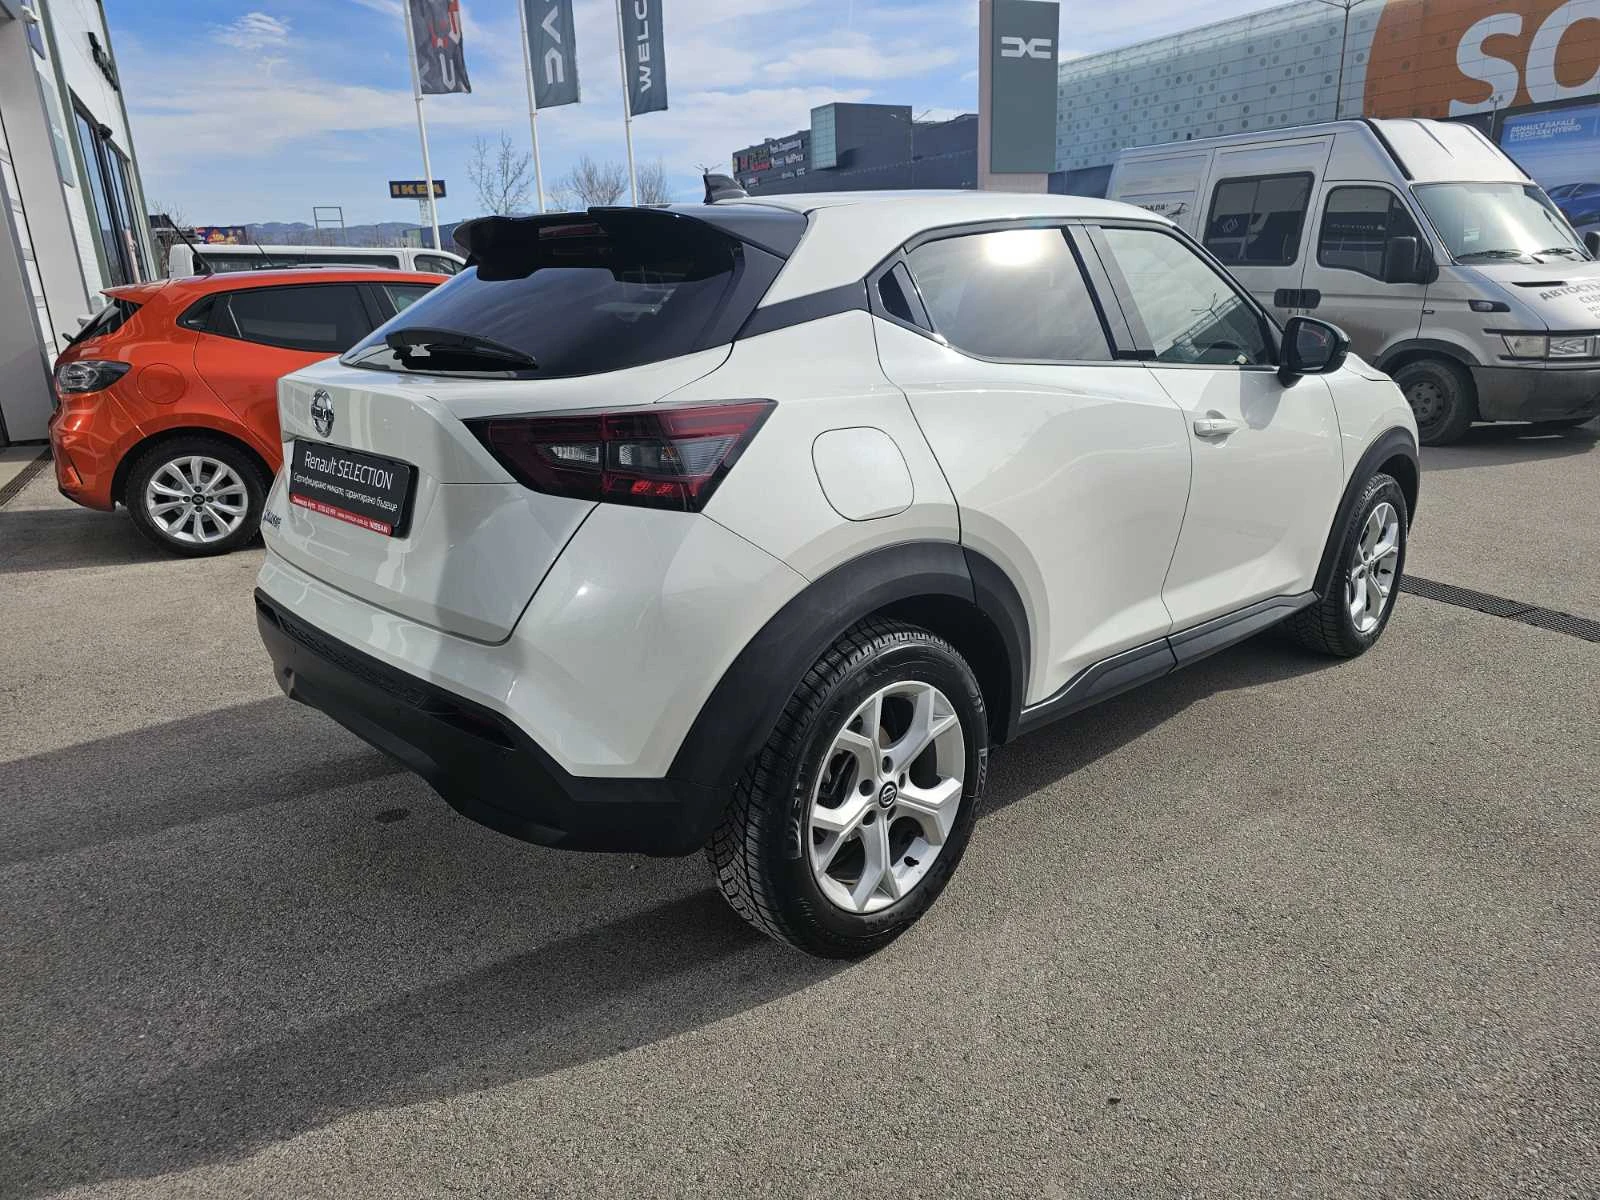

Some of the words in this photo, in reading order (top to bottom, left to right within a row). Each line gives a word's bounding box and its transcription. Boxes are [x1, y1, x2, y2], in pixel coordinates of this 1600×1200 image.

[541, 0, 564, 84] DA
[392, 184, 443, 195] IKEA
[304, 451, 336, 477] Renault
[337, 459, 394, 491] SELECTION
